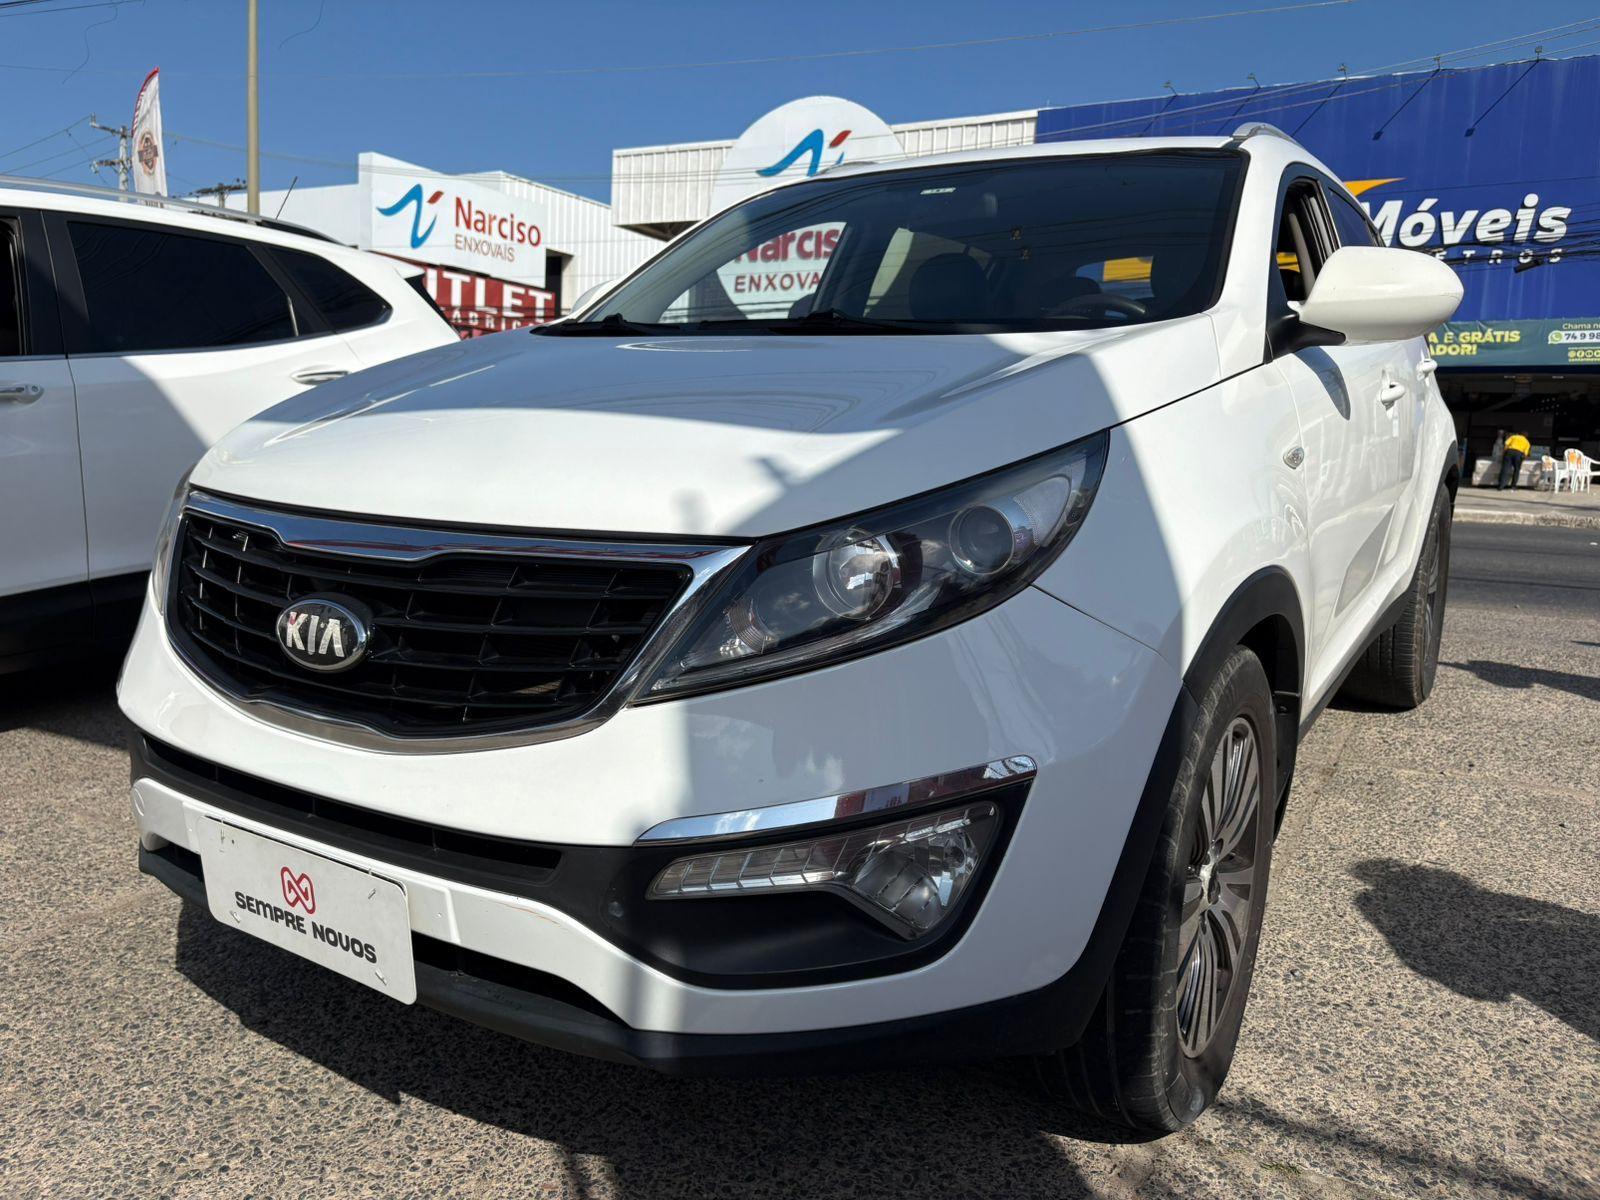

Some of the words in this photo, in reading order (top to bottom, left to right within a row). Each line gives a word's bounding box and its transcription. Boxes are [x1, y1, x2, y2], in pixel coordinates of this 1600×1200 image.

[455, 196, 541, 247] Narciso
[1360, 193, 1572, 248] Móveis
[455, 234, 515, 262] ENXOVAIS
[1459, 328, 1521, 344] GRÁTIS
[1564, 332, 1577, 341] 74
[1580, 332, 1586, 341] 9
[286, 611, 345, 658] KIA
[234, 891, 306, 935] SEMPRE
